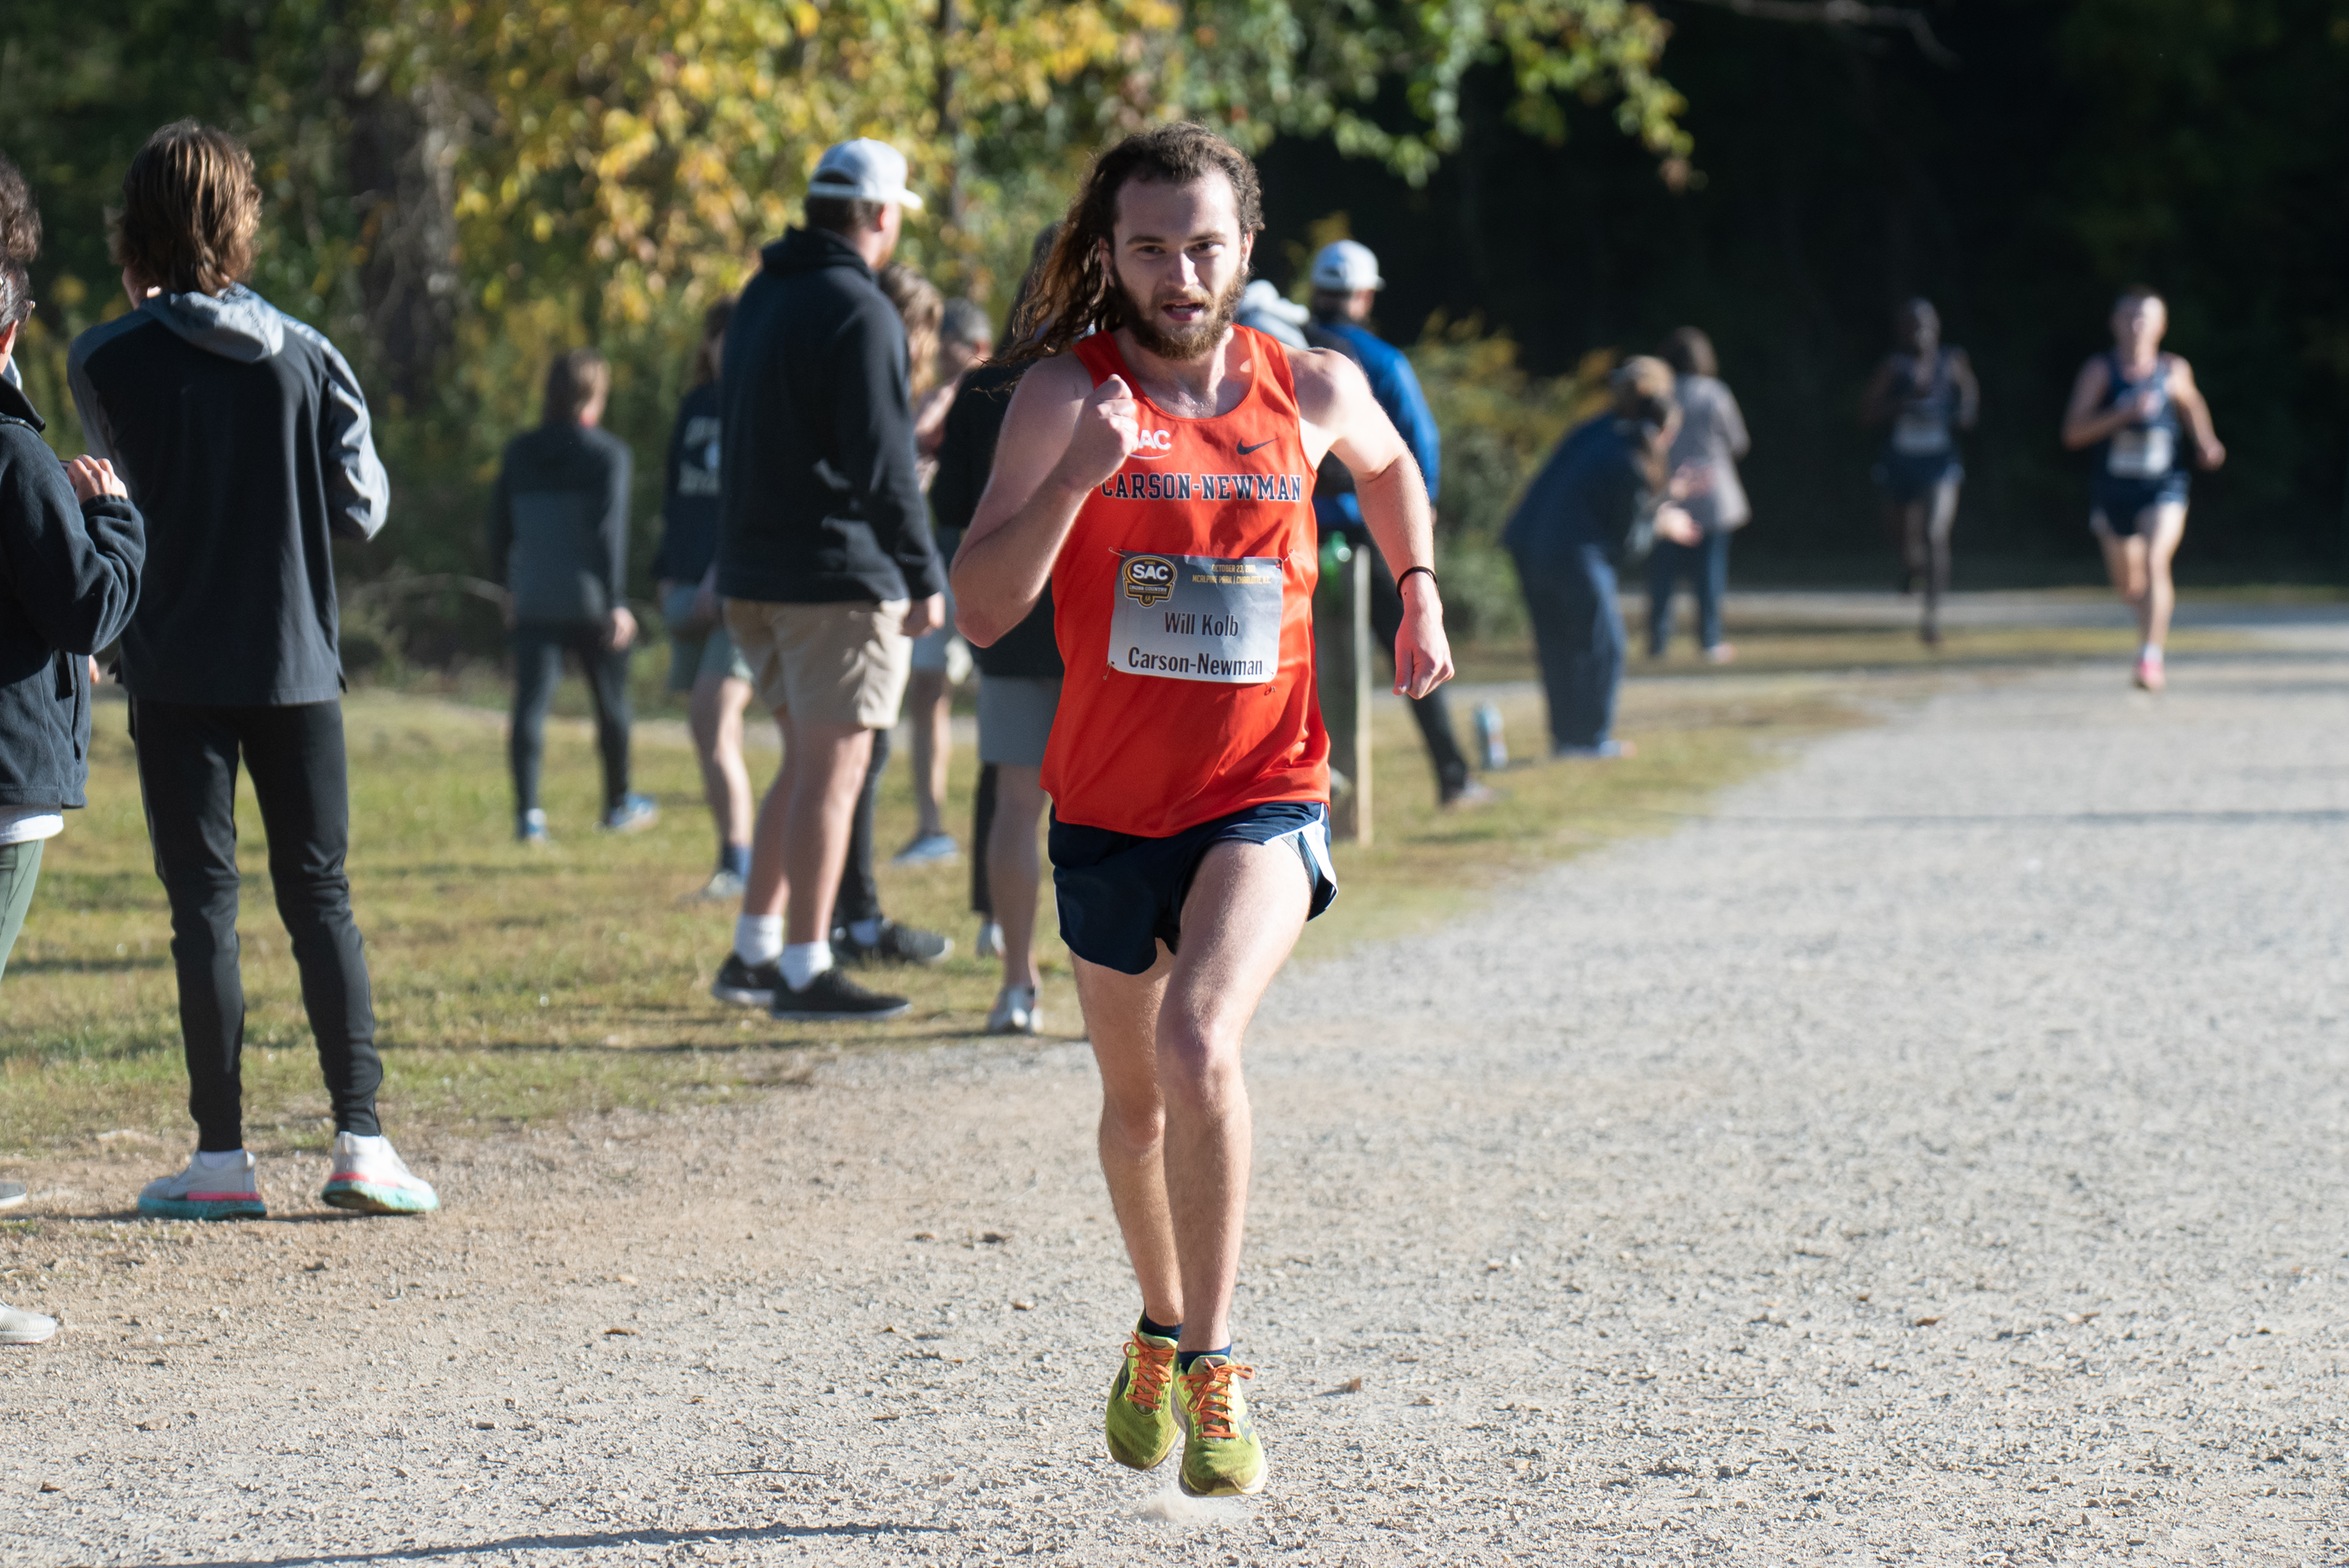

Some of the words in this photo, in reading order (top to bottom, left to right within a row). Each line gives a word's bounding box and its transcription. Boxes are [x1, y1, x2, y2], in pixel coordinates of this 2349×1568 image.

[1137, 429, 1172, 450] AC
[1101, 473, 1302, 502] CARSON-NEWMAN
[1132, 564, 1169, 580] SAC
[1165, 611, 1195, 635] Will
[1202, 613, 1239, 637] Kolb
[1128, 646, 1263, 676] Carson-Newman
